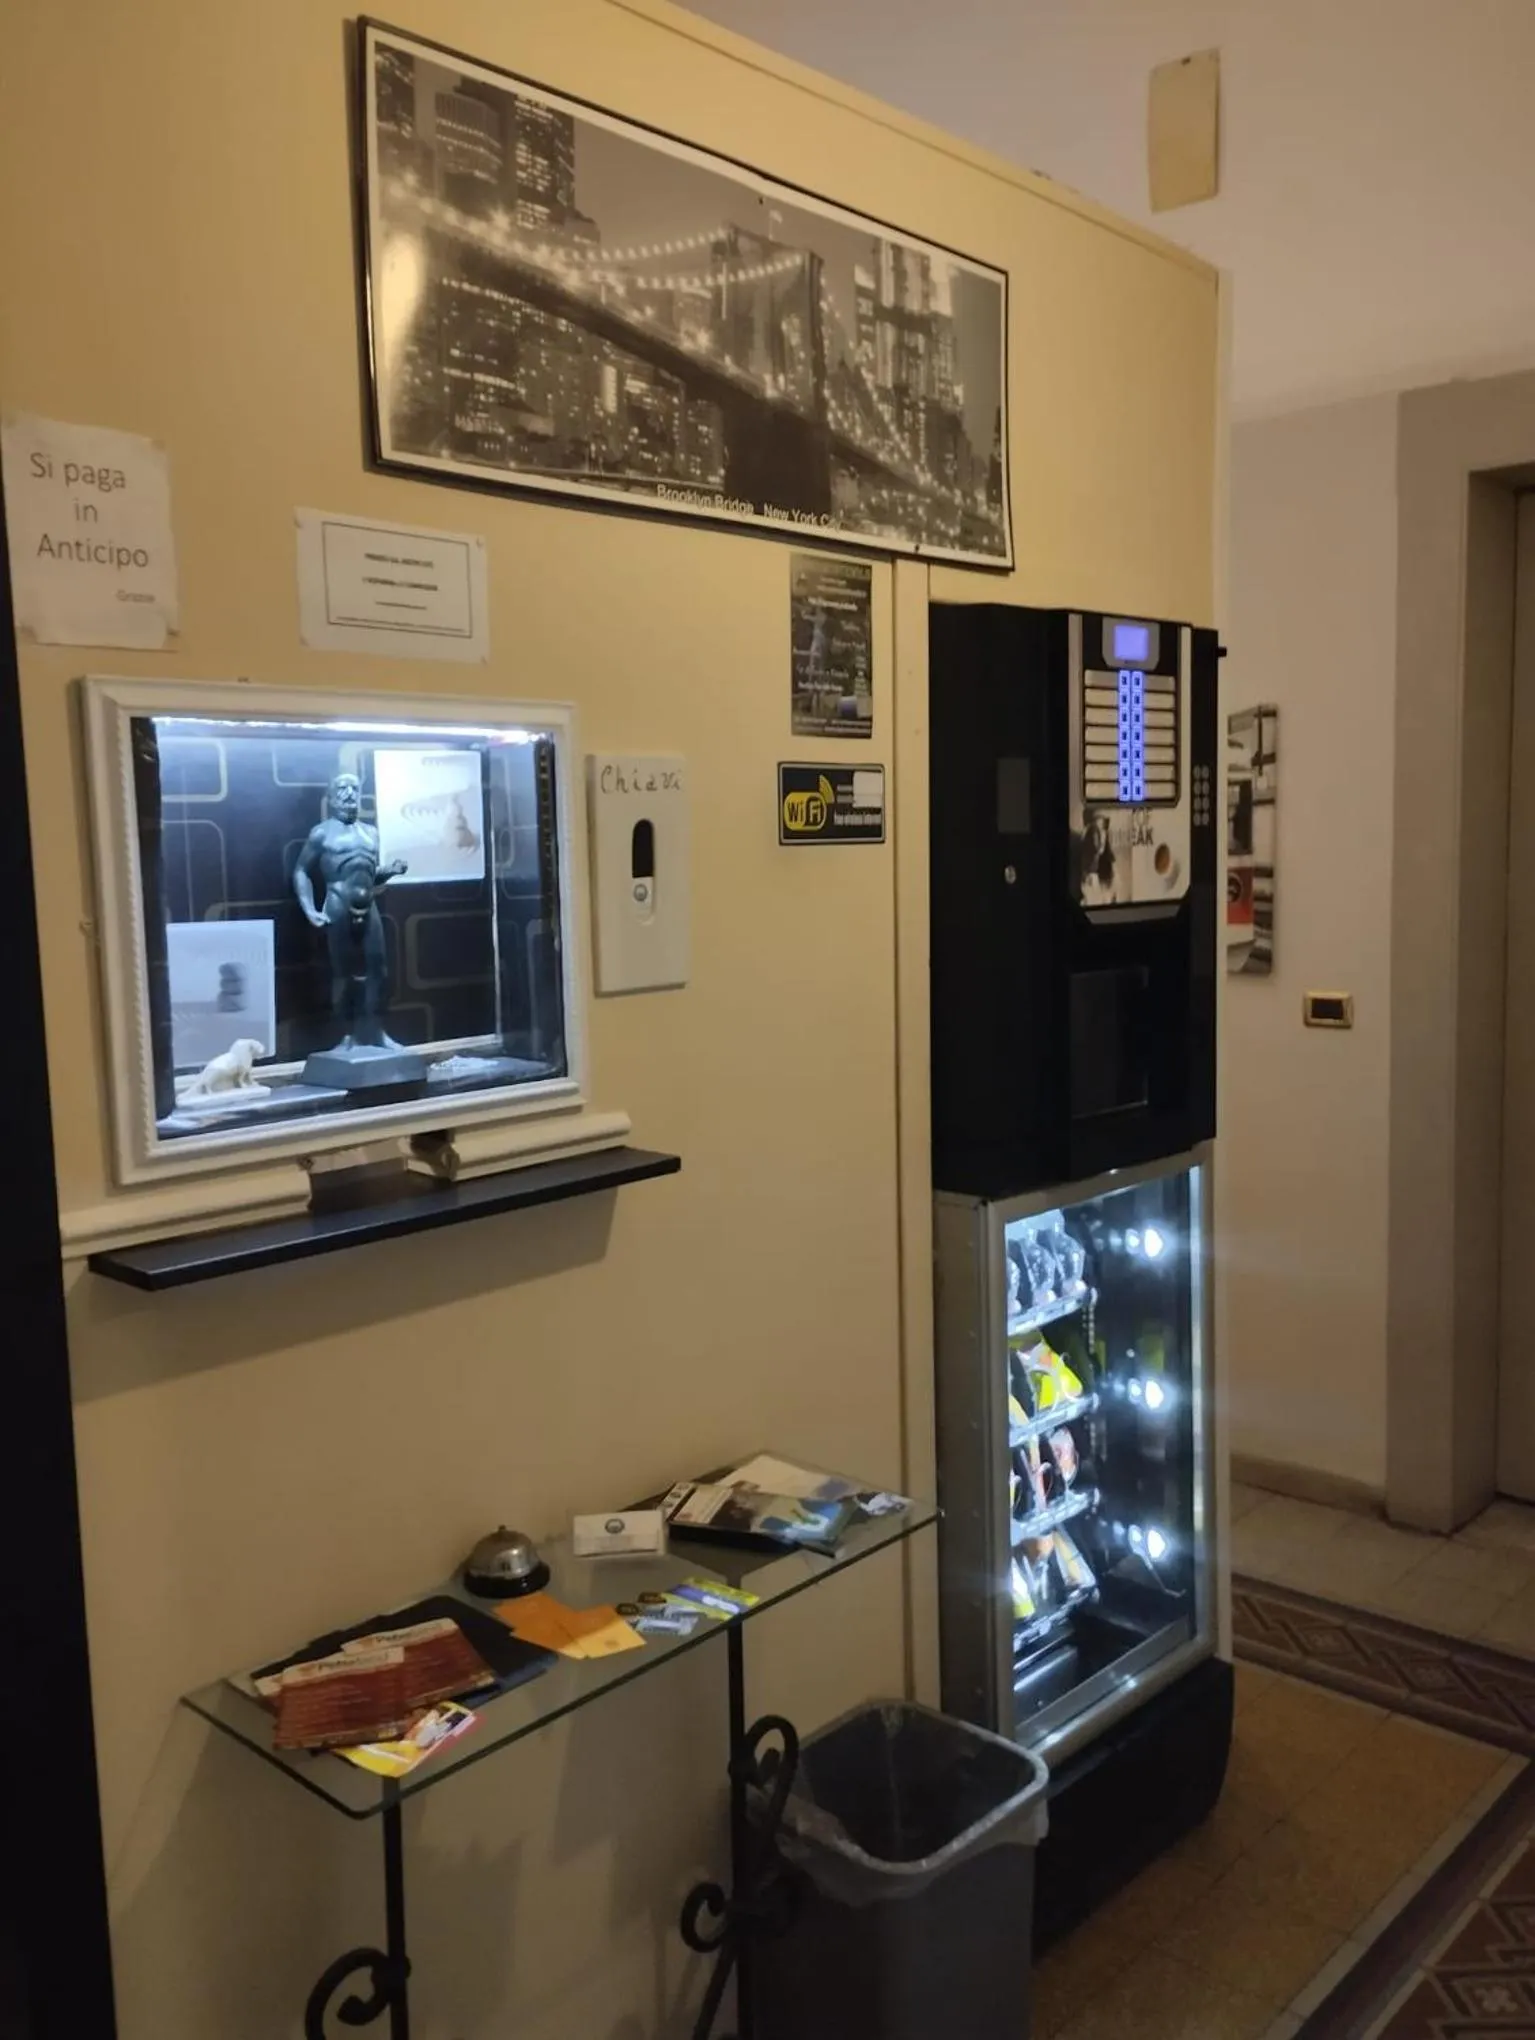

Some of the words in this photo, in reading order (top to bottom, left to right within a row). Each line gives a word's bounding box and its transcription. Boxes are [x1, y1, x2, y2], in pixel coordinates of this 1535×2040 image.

[30, 452, 53, 479] Si
[64, 462, 126, 492] paga
[74, 498, 98, 522] in
[656, 484, 712, 511] Brooklyn
[714, 493, 755, 518] Bridge
[763, 503, 789, 521] New
[791, 508, 818, 527] York
[37, 533, 149, 569] Anticipo
[601, 764, 682, 794] Chiavi
